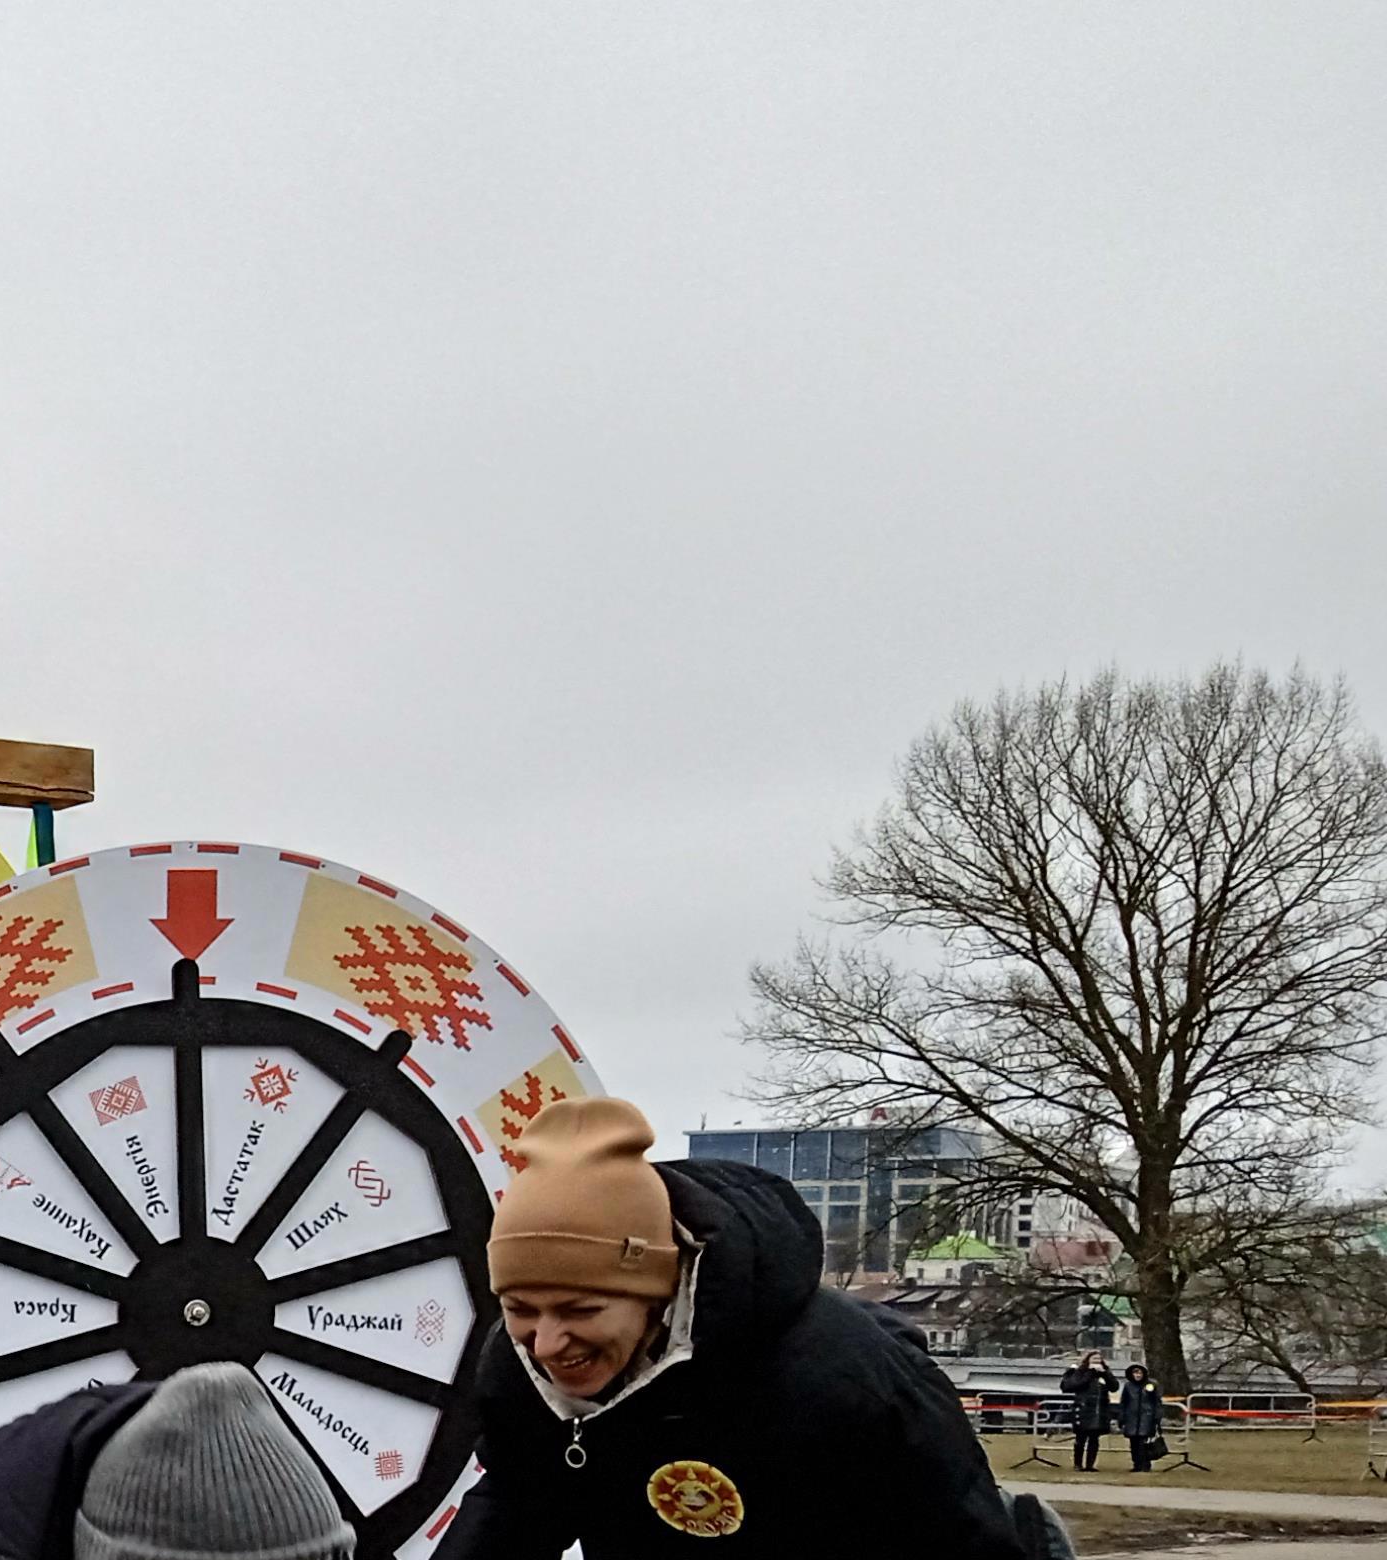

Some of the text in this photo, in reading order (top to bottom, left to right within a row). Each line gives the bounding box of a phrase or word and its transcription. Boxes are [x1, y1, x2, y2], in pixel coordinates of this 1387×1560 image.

[126, 1135, 169, 1218] Энергія
[211, 1120, 265, 1226] Дастатак
[32, 1193, 113, 1260] Каханне
[285, 1202, 349, 1251] Шлях
[14, 1298, 78, 1323] Краса
[307, 1305, 403, 1331] Ураджай
[270, 1371, 370, 1456] Маладосць
